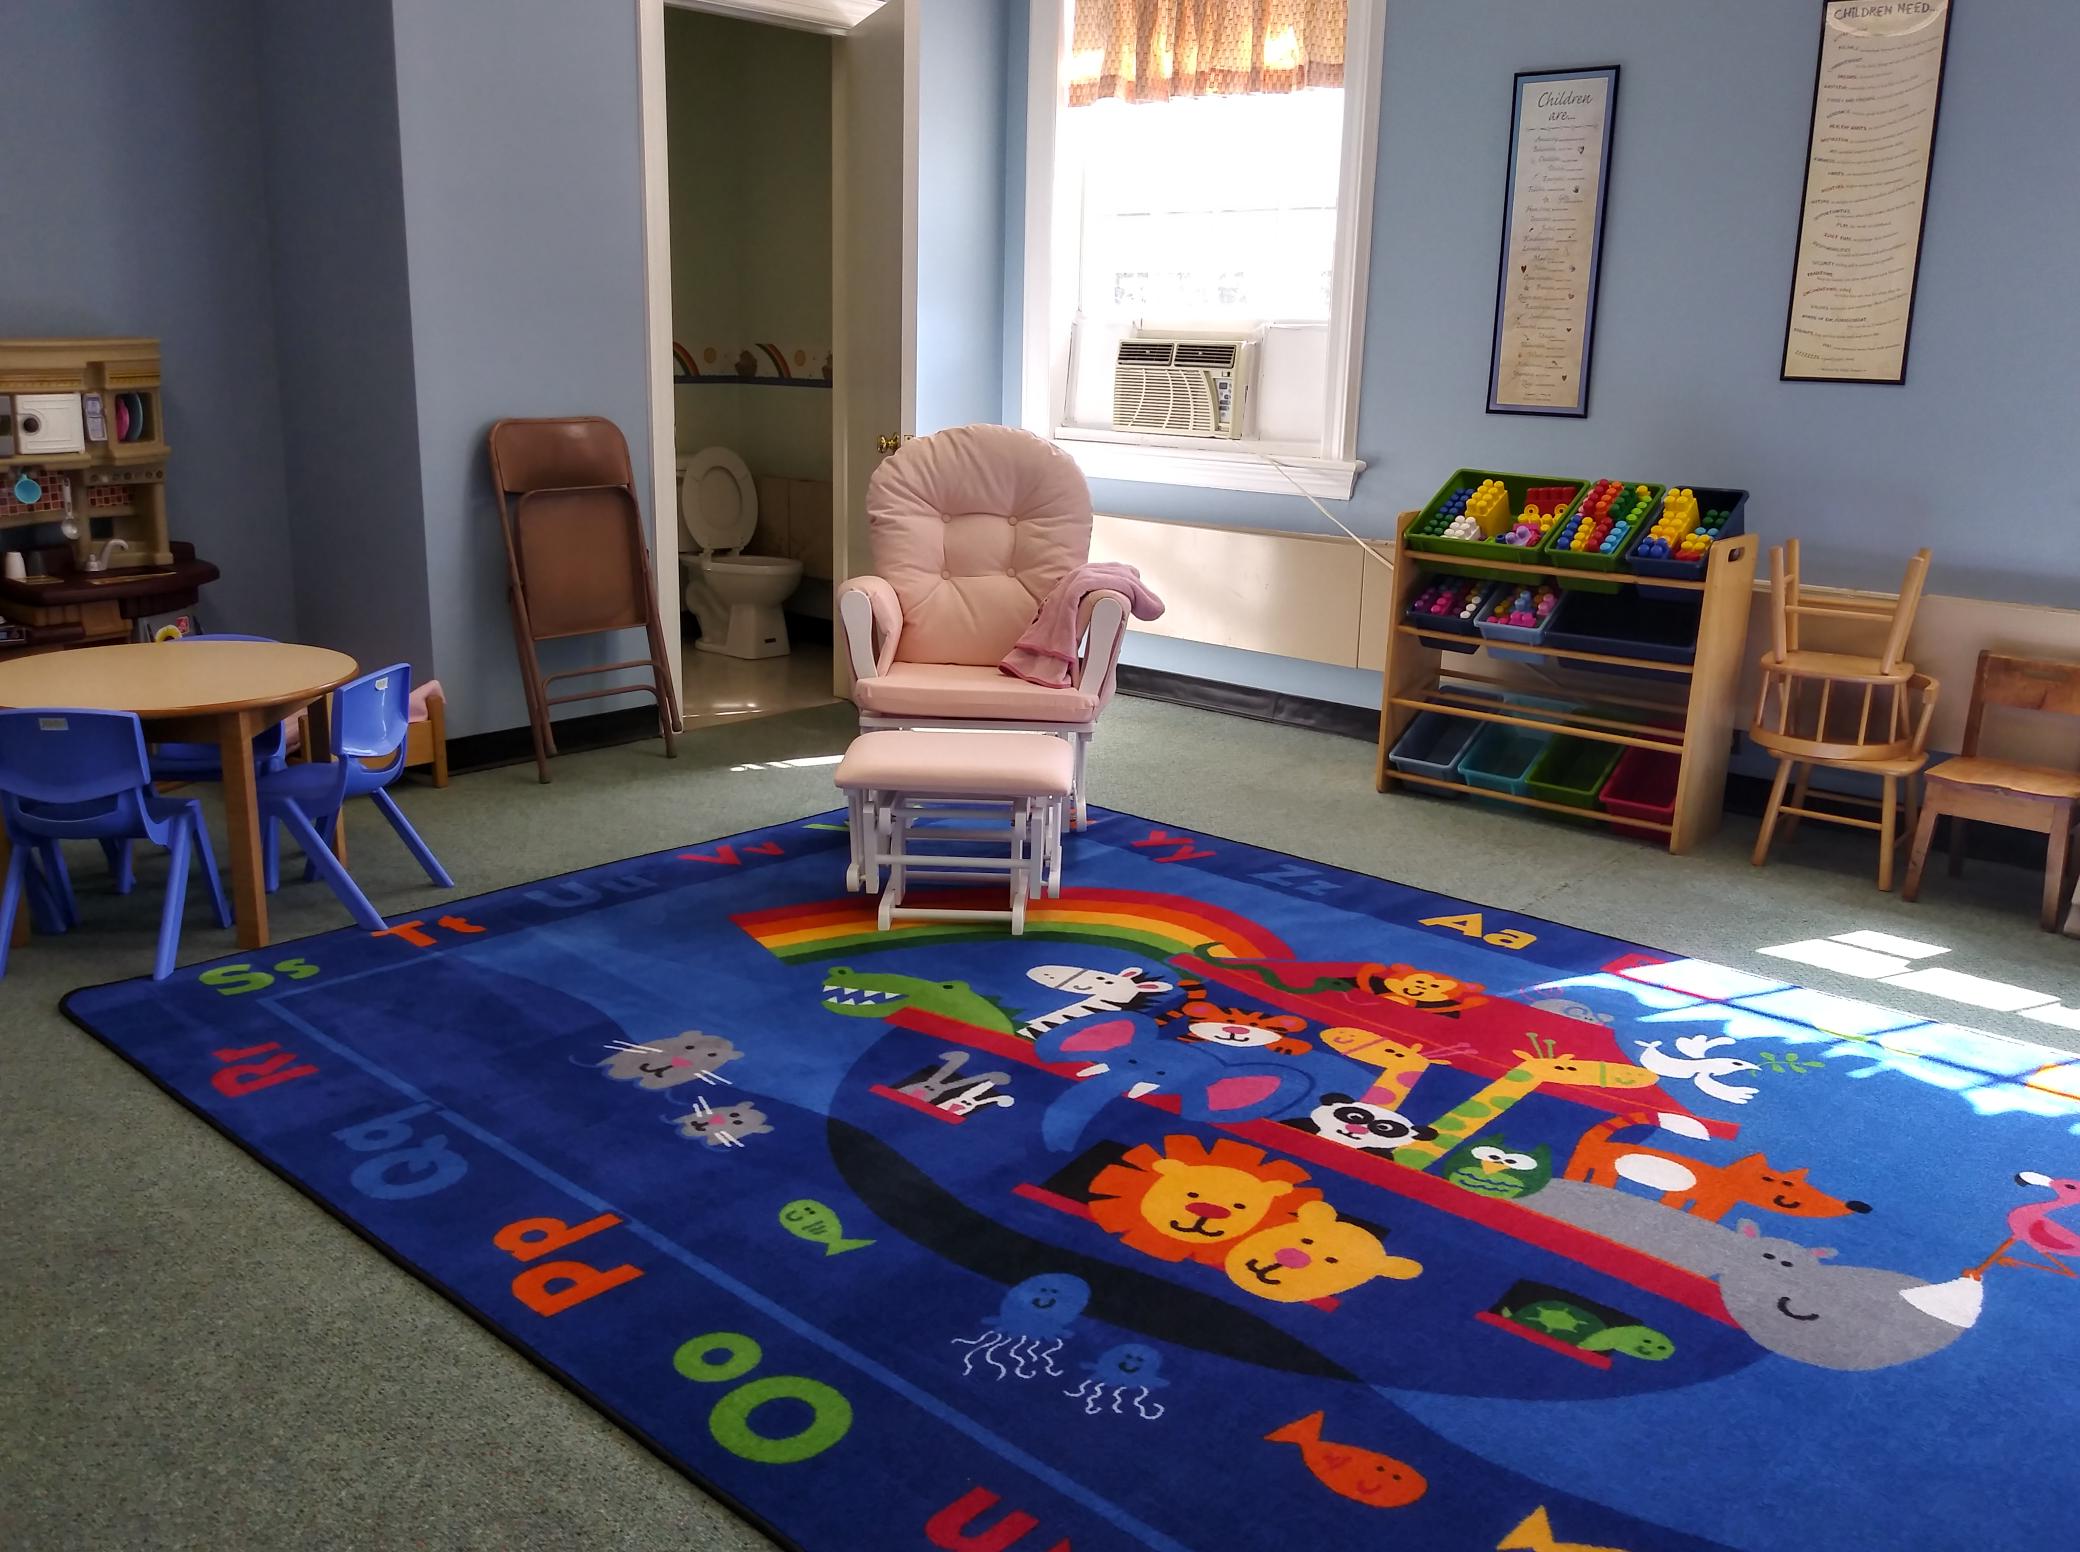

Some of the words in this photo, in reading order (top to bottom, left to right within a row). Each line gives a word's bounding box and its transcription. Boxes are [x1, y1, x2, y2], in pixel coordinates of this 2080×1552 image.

[1834, 6, 1893, 20] CHILDREN
[1538, 91, 1593, 108] Children
[1417, 913, 1538, 951] Aa
